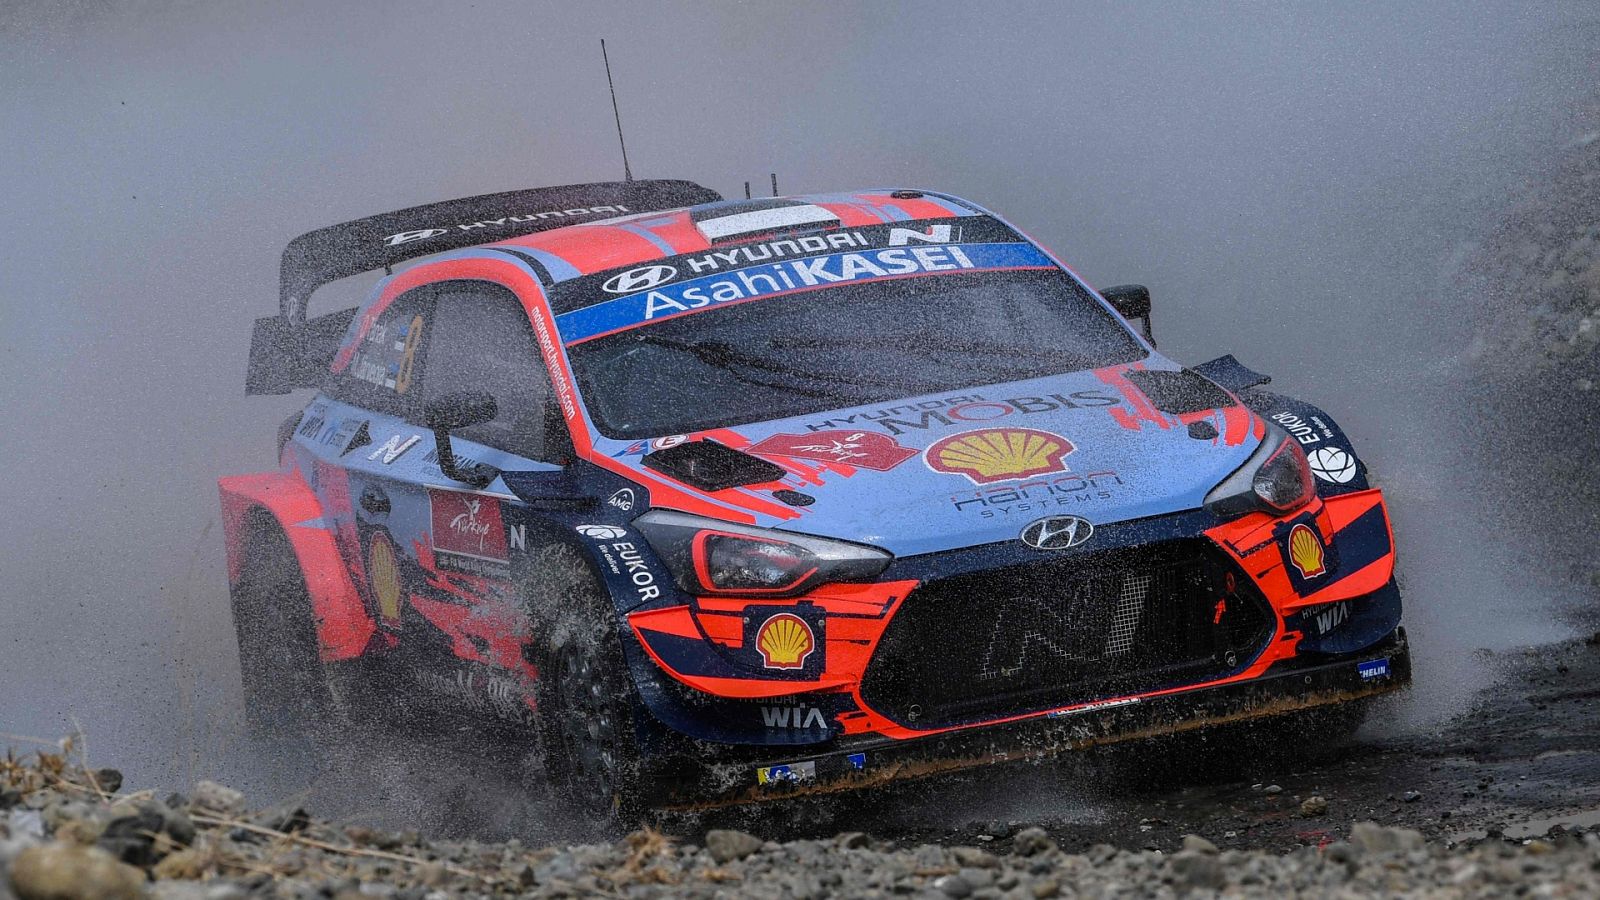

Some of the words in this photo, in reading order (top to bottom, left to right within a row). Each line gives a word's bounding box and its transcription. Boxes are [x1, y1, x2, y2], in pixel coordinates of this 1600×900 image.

[459, 205, 629, 230] HYUNDAI
[687, 231, 869, 272] HYUNDAI
[643, 245, 976, 320] AsahiKASEI
[397, 314, 423, 394] 8
[531, 306, 576, 420] motorsport.hyundai.com
[805, 395, 987, 431] HYUNDAI
[877, 389, 1121, 436] MOBIS
[1272, 411, 1320, 445] EUKOR
[366, 433, 422, 465] N
[607, 496, 632, 511] AMG
[980, 490, 1112, 519] SYSTEMS
[449, 513, 490, 552] Türkiye
[604, 552, 621, 575] deliver
[612, 542, 660, 602] EUKOR
[1316, 600, 1349, 635] WIA
[761, 702, 828, 729] WIA
